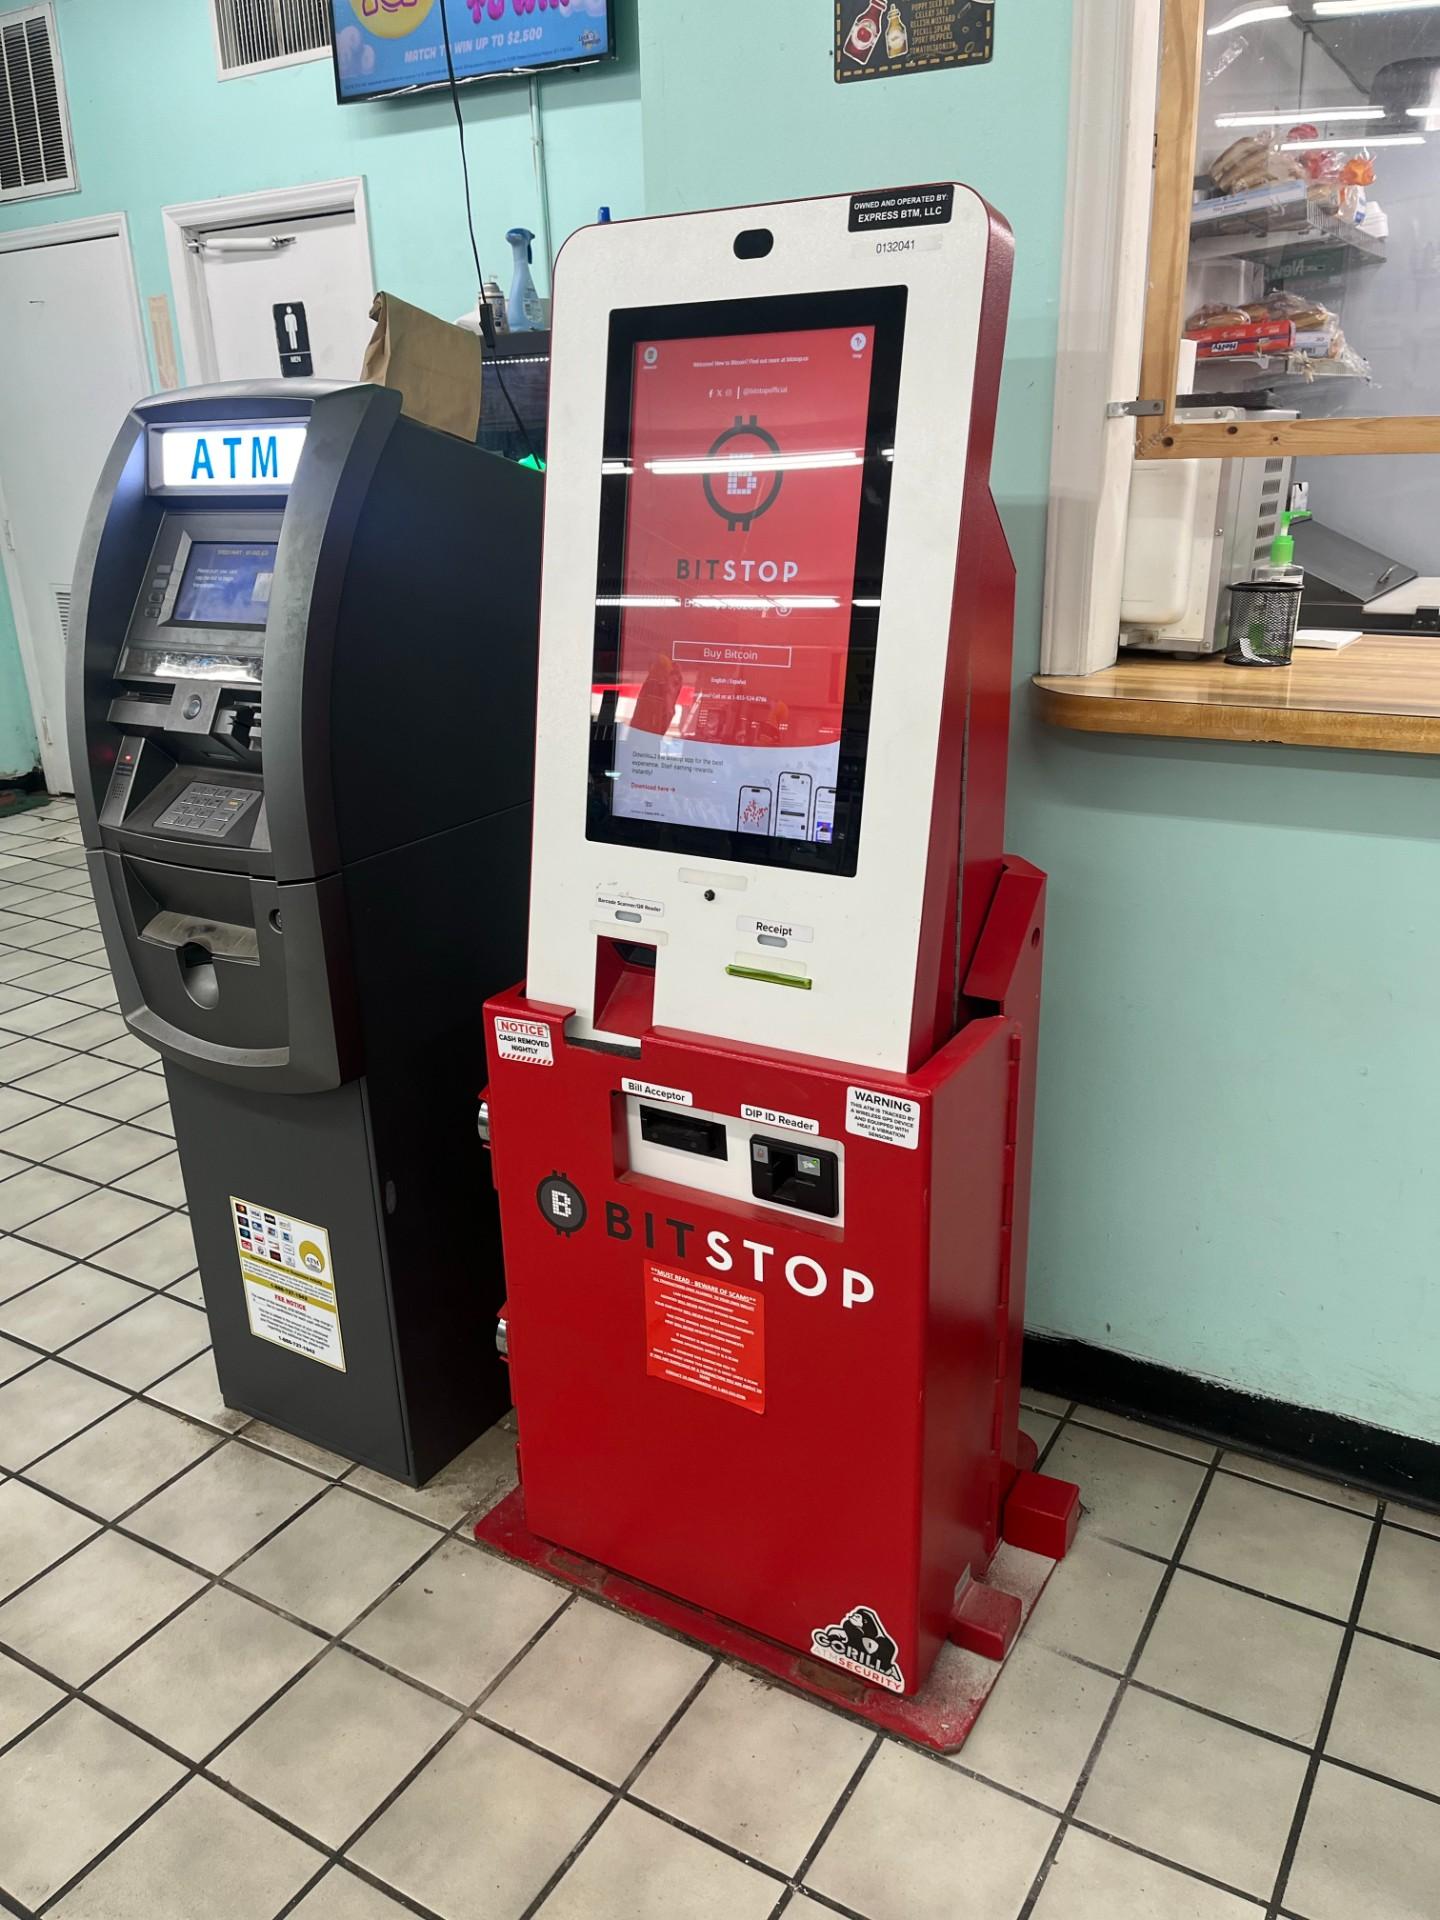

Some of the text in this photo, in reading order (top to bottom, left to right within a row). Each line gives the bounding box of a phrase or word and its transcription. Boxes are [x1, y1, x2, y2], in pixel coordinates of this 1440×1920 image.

[404, 47, 437, 63] MATCH
[454, 39, 473, 55] WIN
[475, 37, 489, 50] UP
[492, 33, 504, 48] TO
[854, 201, 880, 210] OWNED
[881, 199, 895, 207] AND
[897, 195, 935, 206] OPERATED
[858, 206, 942, 223] EXPRESS BTM, LLC
[876, 240, 915, 254] 0132041
[191, 436, 278, 479] ATM
[676, 559, 799, 583] BITSTOP
[704, 648, 758, 661] Buy Bitcoin
[756, 921, 792, 937] Receipt
[501, 1021, 544, 1036] NOTICE
[499, 1034, 549, 1048] CASH REMOVED
[511, 1045, 538, 1054] NIGHTLY
[628, 1081, 685, 1102] Bill Acceptor
[855, 1090, 911, 1112] WARNING
[745, 1107, 814, 1131] DIP ID Reader
[856, 1109, 881, 1120] WIRELESS
[894, 1118, 914, 1128] DEVICE
[882, 1109, 907, 1119] TRACKED
[867, 1118, 893, 1129] EQUIPPED
[895, 1125, 909, 1133] WITH
[877, 1126, 905, 1139] VIBRATION
[868, 1131, 893, 1142] SENSORS
[605, 1200, 875, 1309] BITSTOP
[674, 1274, 690, 1284] READ
[694, 1280, 719, 1293] BEWARE
[286, 1298, 307, 1311] NOTICE
[814, 1628, 901, 1681] GORILLA
[838, 1657, 901, 1690] SECURITY
